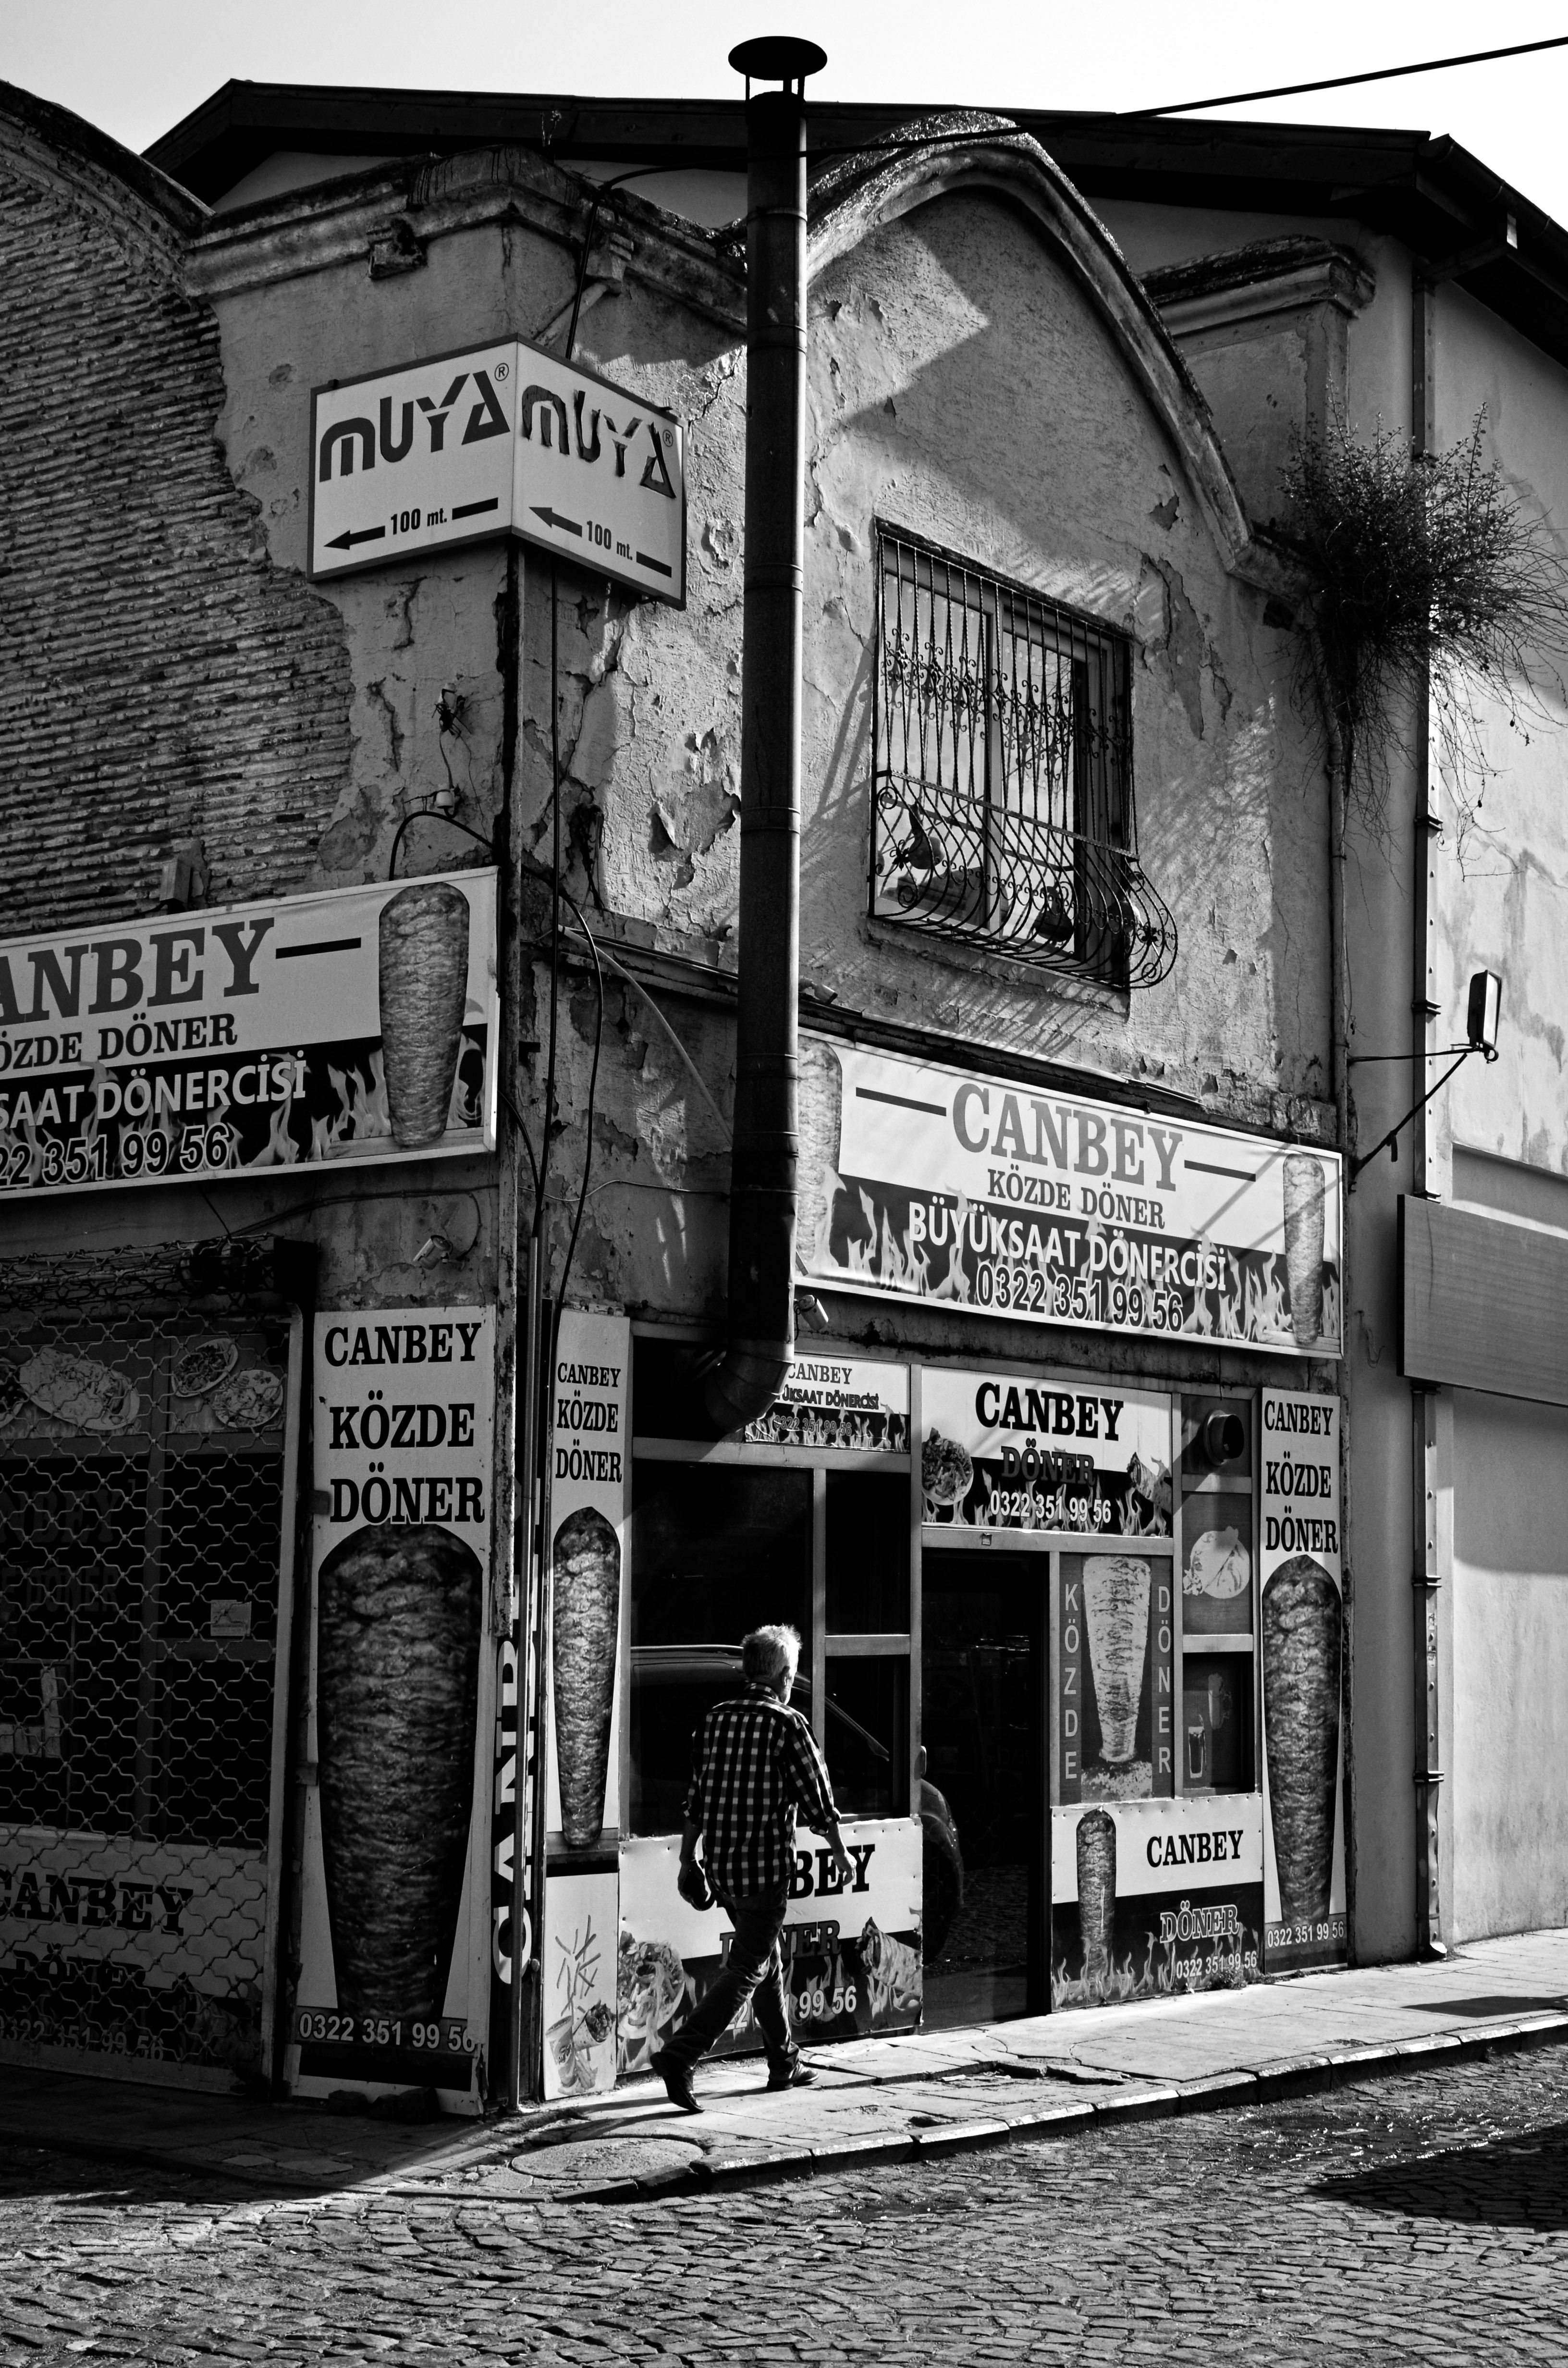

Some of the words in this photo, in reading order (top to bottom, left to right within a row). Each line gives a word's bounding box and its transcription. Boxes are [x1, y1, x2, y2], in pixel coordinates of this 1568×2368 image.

[391, 508, 420, 535] 100
[427, 508, 447, 526] mt.
[587, 520, 612, 550] 100
[617, 542, 633, 561] mt.
[98, 1013, 238, 1061] DÖNER
[97, 1050, 306, 1120] DÖNERCİSİ
[42, 1134, 107, 1184] 351
[121, 1128, 169, 1177] 99
[180, 1122, 230, 1172] 56
[953, 1083, 1182, 1191] CANBEY
[989, 1164, 1070, 1210] KÖZDE
[1082, 1183, 1165, 1228] DÖNER
[909, 1197, 1080, 1270] BÜYÜKSAAT
[1090, 1231, 1226, 1291] DÖNERCİSİ
[977, 1264, 1046, 1313] 0322
[1056, 1273, 1102, 1322] 351
[1113, 1285, 1145, 1327] 99
[1152, 1290, 1183, 1331] 56
[325, 1323, 481, 1366] CANBEY
[557, 1362, 621, 1388] CANBEY
[777, 1384, 823, 1405] ÜKSAAT
[826, 1390, 879, 1410] DÖNERCİSİ
[330, 1390, 474, 1449] KÖZDE
[557, 1390, 618, 1432] KÖZDE
[774, 1415, 799, 1430] 0322
[802, 1418, 820, 1433] 351
[824, 1420, 836, 1434] 99
[840, 1422, 852, 1436] 56
[976, 1381, 1123, 1441] CANBEY
[1264, 1400, 1333, 1436] CANBEY
[556, 1439, 622, 1483] DÖNER
[1001, 1438, 1095, 1487] DÖNER
[1266, 1451, 1331, 1498] KÖZDE
[331, 1462, 485, 1523] DÖNER
[991, 1490, 1030, 1517] 0322
[1036, 1494, 1062, 1519] 351
[1069, 1497, 1088, 1522] 99
[1093, 1499, 1111, 1523] 56
[1265, 1505, 1338, 1554] DÖNER
[1064, 1583, 1079, 1779] KÖZDE
[1158, 1586, 1171, 1773] DÖNER
[1147, 1830, 1243, 1867] CANBEY
[787, 1844, 875, 1900] BEY
[1160, 1900, 1239, 1943] DÖNER
[1268, 1928, 1292, 1948] 0322
[1296, 1924, 1312, 1943] 351
[1317, 1923, 1329, 1940] 99
[1332, 1921, 1344, 1938] 56
[1176, 1958, 1202, 1979] 0322
[1205, 1955, 1224, 1974] 351
[1228, 1953, 1241, 1970] 99
[1244, 1950, 1257, 1969] 56
[799, 1990, 824, 2018] 99
[832, 1986, 857, 2014] 56
[299, 2013, 354, 2041] 0322
[362, 2019, 401, 2045] 351
[412, 2023, 440, 2048] 99
[448, 2026, 475, 2052] 56
